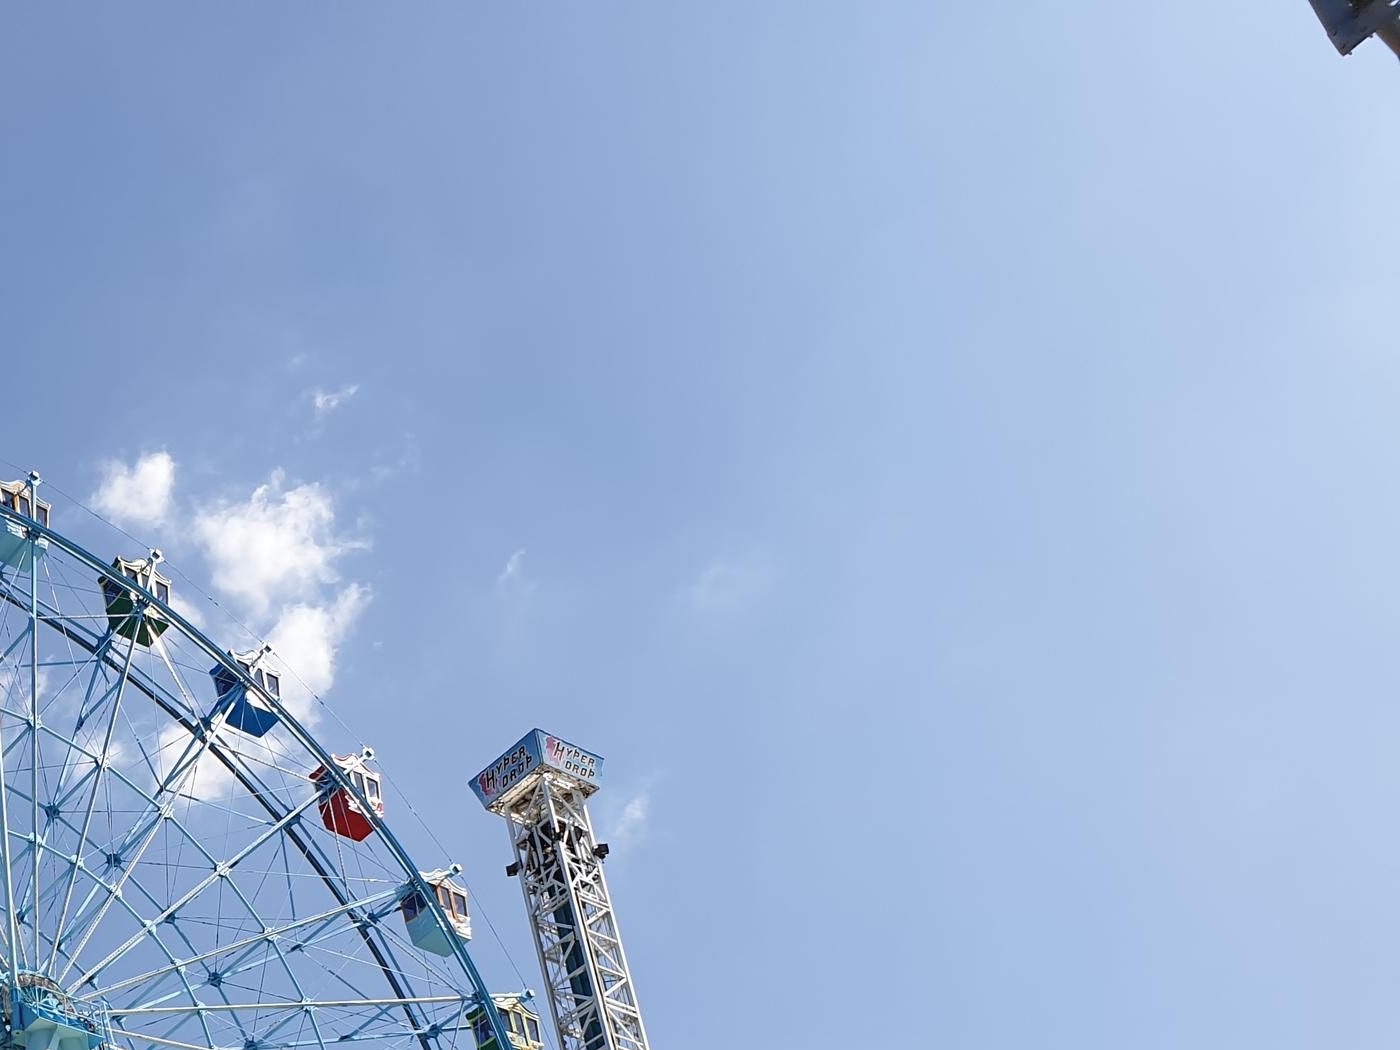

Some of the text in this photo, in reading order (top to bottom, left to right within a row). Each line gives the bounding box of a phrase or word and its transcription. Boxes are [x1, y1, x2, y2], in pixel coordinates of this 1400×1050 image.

[486, 746, 527, 789] HYPER
[553, 742, 596, 767] HYPER
[502, 754, 532, 789] DROP
[565, 761, 596, 779] DROP
